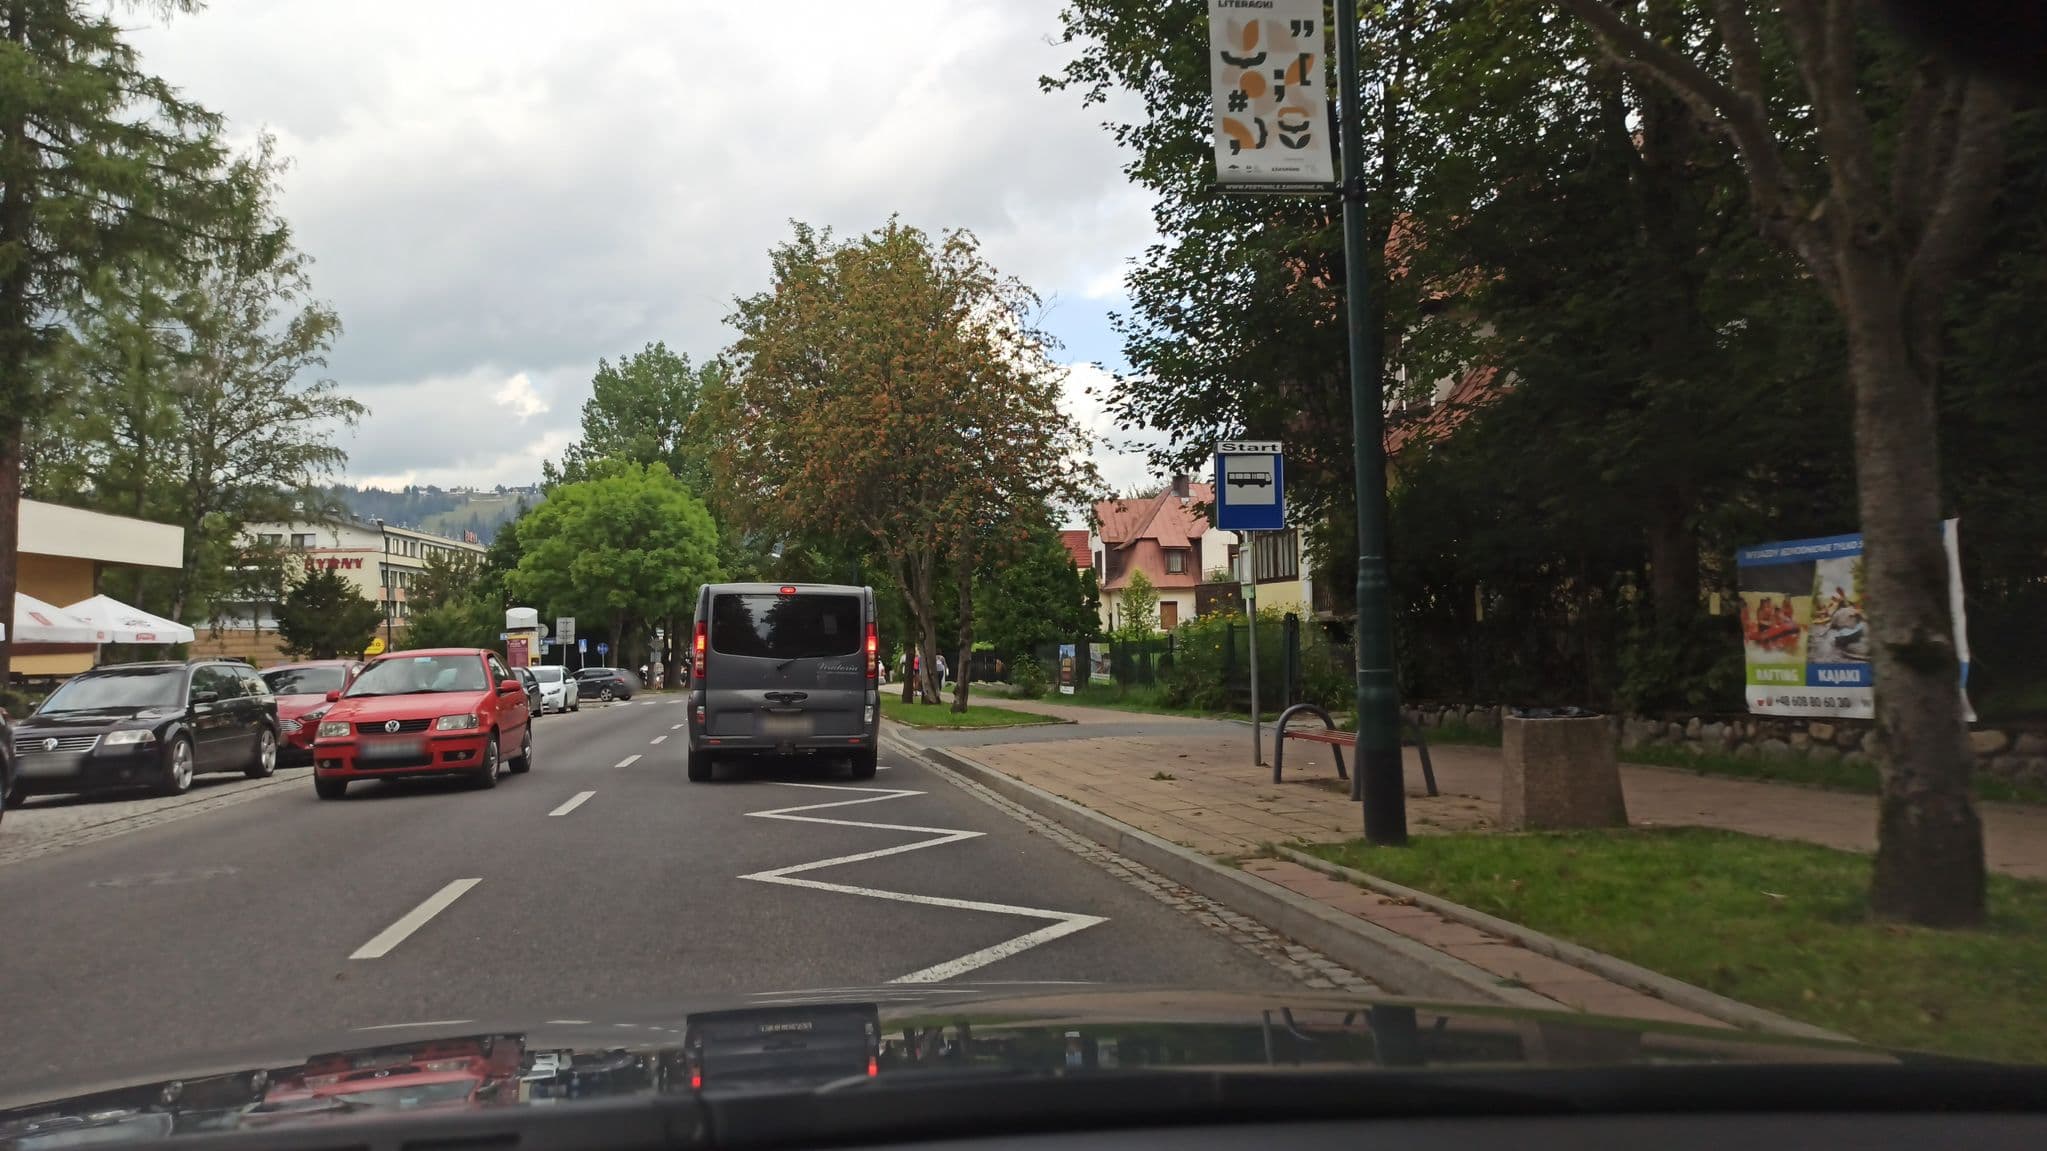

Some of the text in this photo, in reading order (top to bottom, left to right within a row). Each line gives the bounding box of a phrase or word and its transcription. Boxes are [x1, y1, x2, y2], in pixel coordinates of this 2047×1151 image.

[1221, 443, 1280, 452] Start
[1755, 668, 1799, 682] RAFTING
[1817, 669, 1861, 684] KAJAKI
